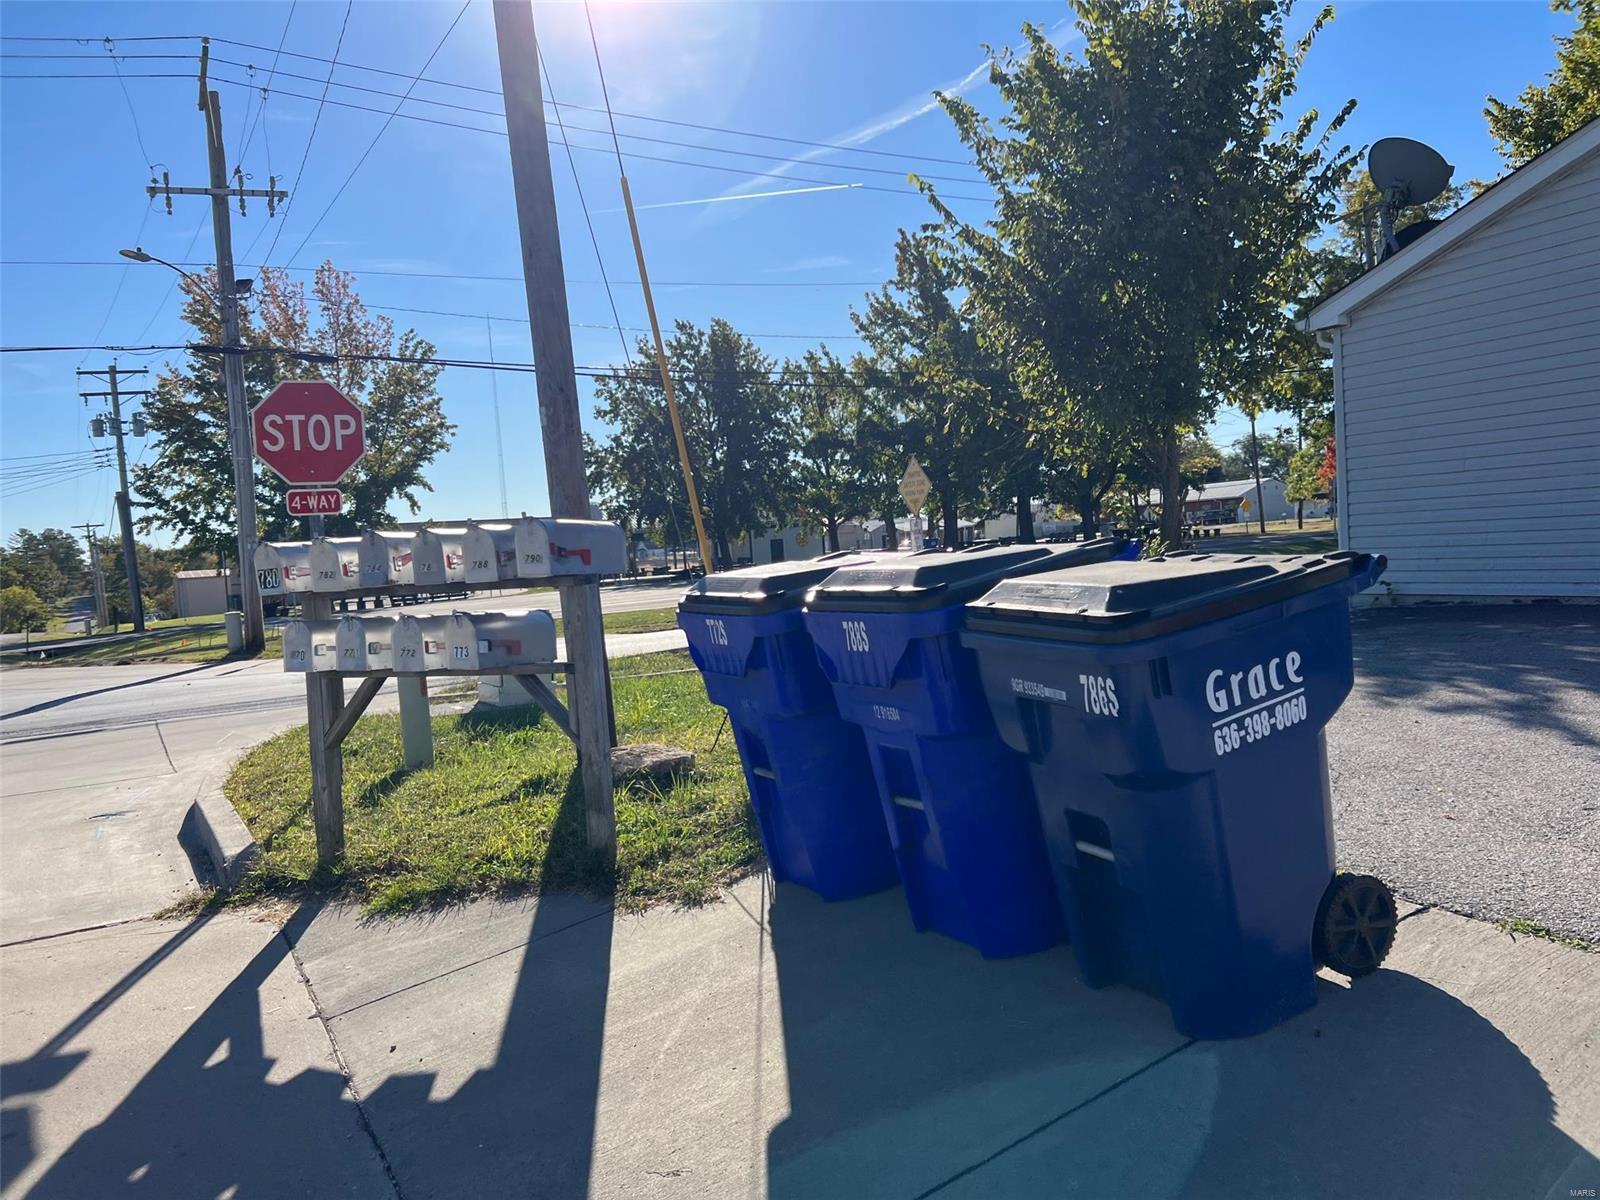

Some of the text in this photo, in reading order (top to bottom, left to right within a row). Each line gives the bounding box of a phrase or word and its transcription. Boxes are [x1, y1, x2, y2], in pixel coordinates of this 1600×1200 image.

[262, 414, 356, 452] STOP
[291, 494, 337, 510] 4-WAY
[472, 560, 488, 569] 788
[524, 554, 543, 564] 790
[259, 569, 279, 589] 780
[705, 619, 728, 646] 772S
[842, 621, 869, 652] 788S
[400, 648, 415, 657] 772
[454, 646, 469, 658] 773
[1205, 651, 1304, 713] Grace
[1079, 674, 1119, 717] 786S
[1213, 695, 1307, 756] 636-398-8060
